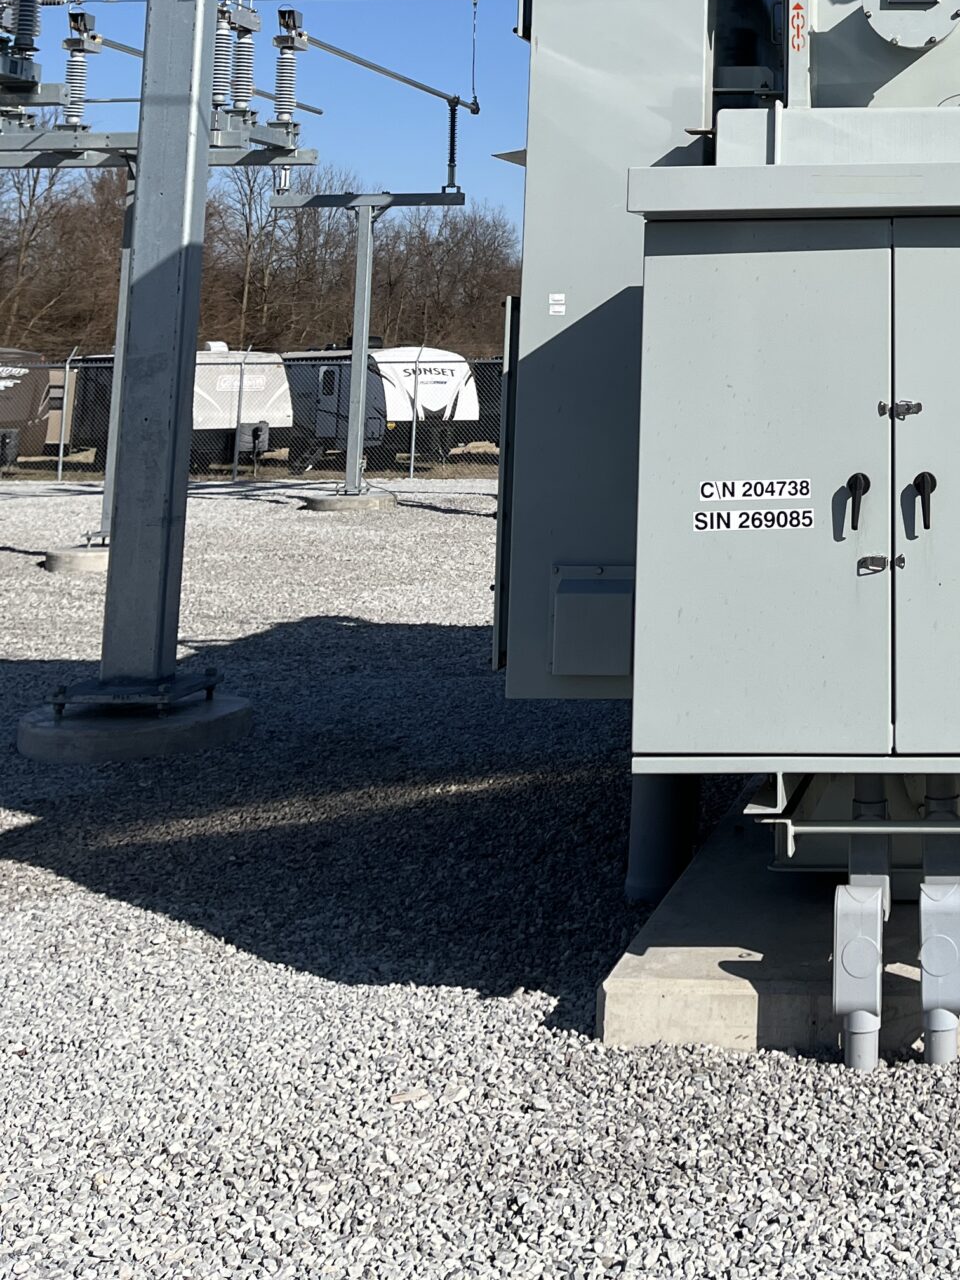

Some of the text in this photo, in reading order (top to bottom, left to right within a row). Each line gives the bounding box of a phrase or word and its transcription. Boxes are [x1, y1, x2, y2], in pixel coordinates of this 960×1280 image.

[403, 367, 455, 377] SUNSET
[742, 480, 810, 497] 204738
[738, 510, 813, 529] 269085
